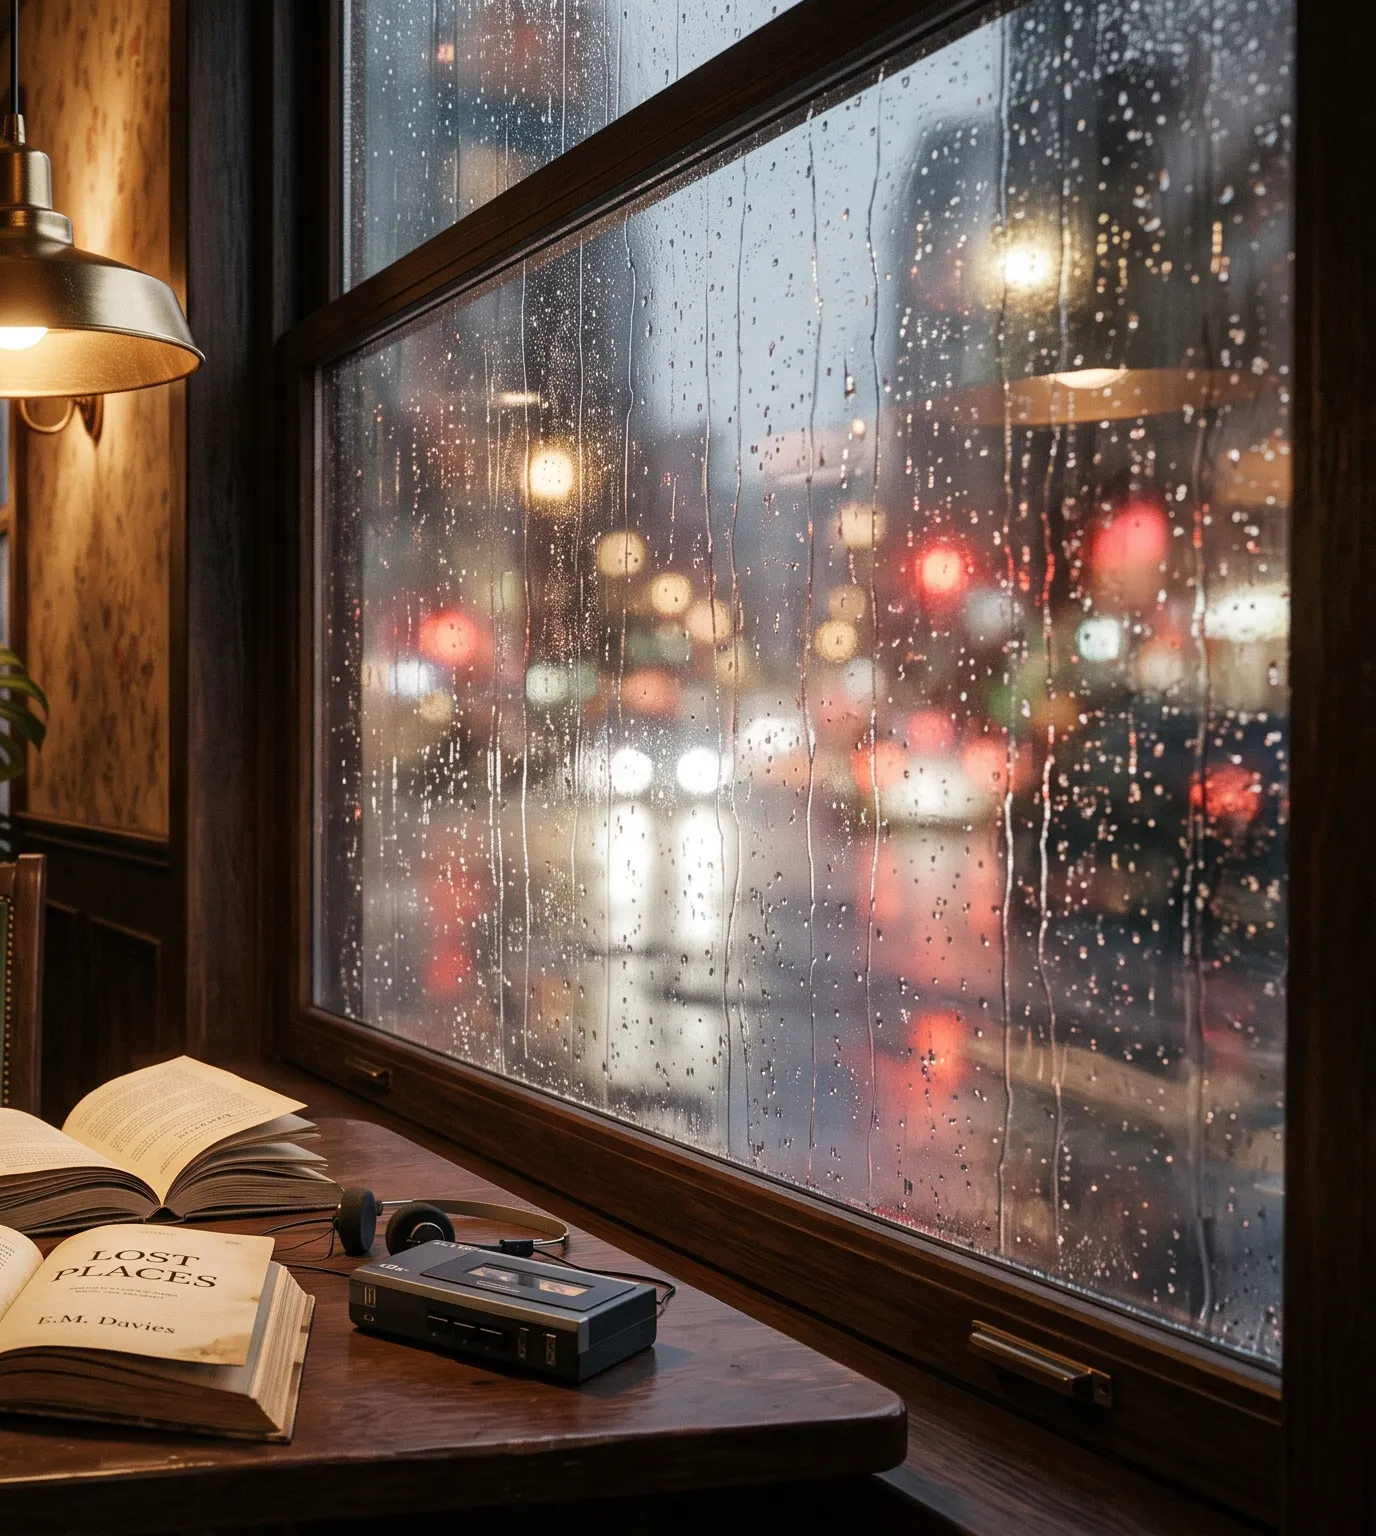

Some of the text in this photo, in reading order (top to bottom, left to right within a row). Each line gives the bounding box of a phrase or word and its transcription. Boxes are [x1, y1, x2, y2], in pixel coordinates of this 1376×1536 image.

[88, 1249, 200, 1267] LOST
[50, 1265, 218, 1288] PLACES
[37, 1314, 176, 1334] E.M. Davies
